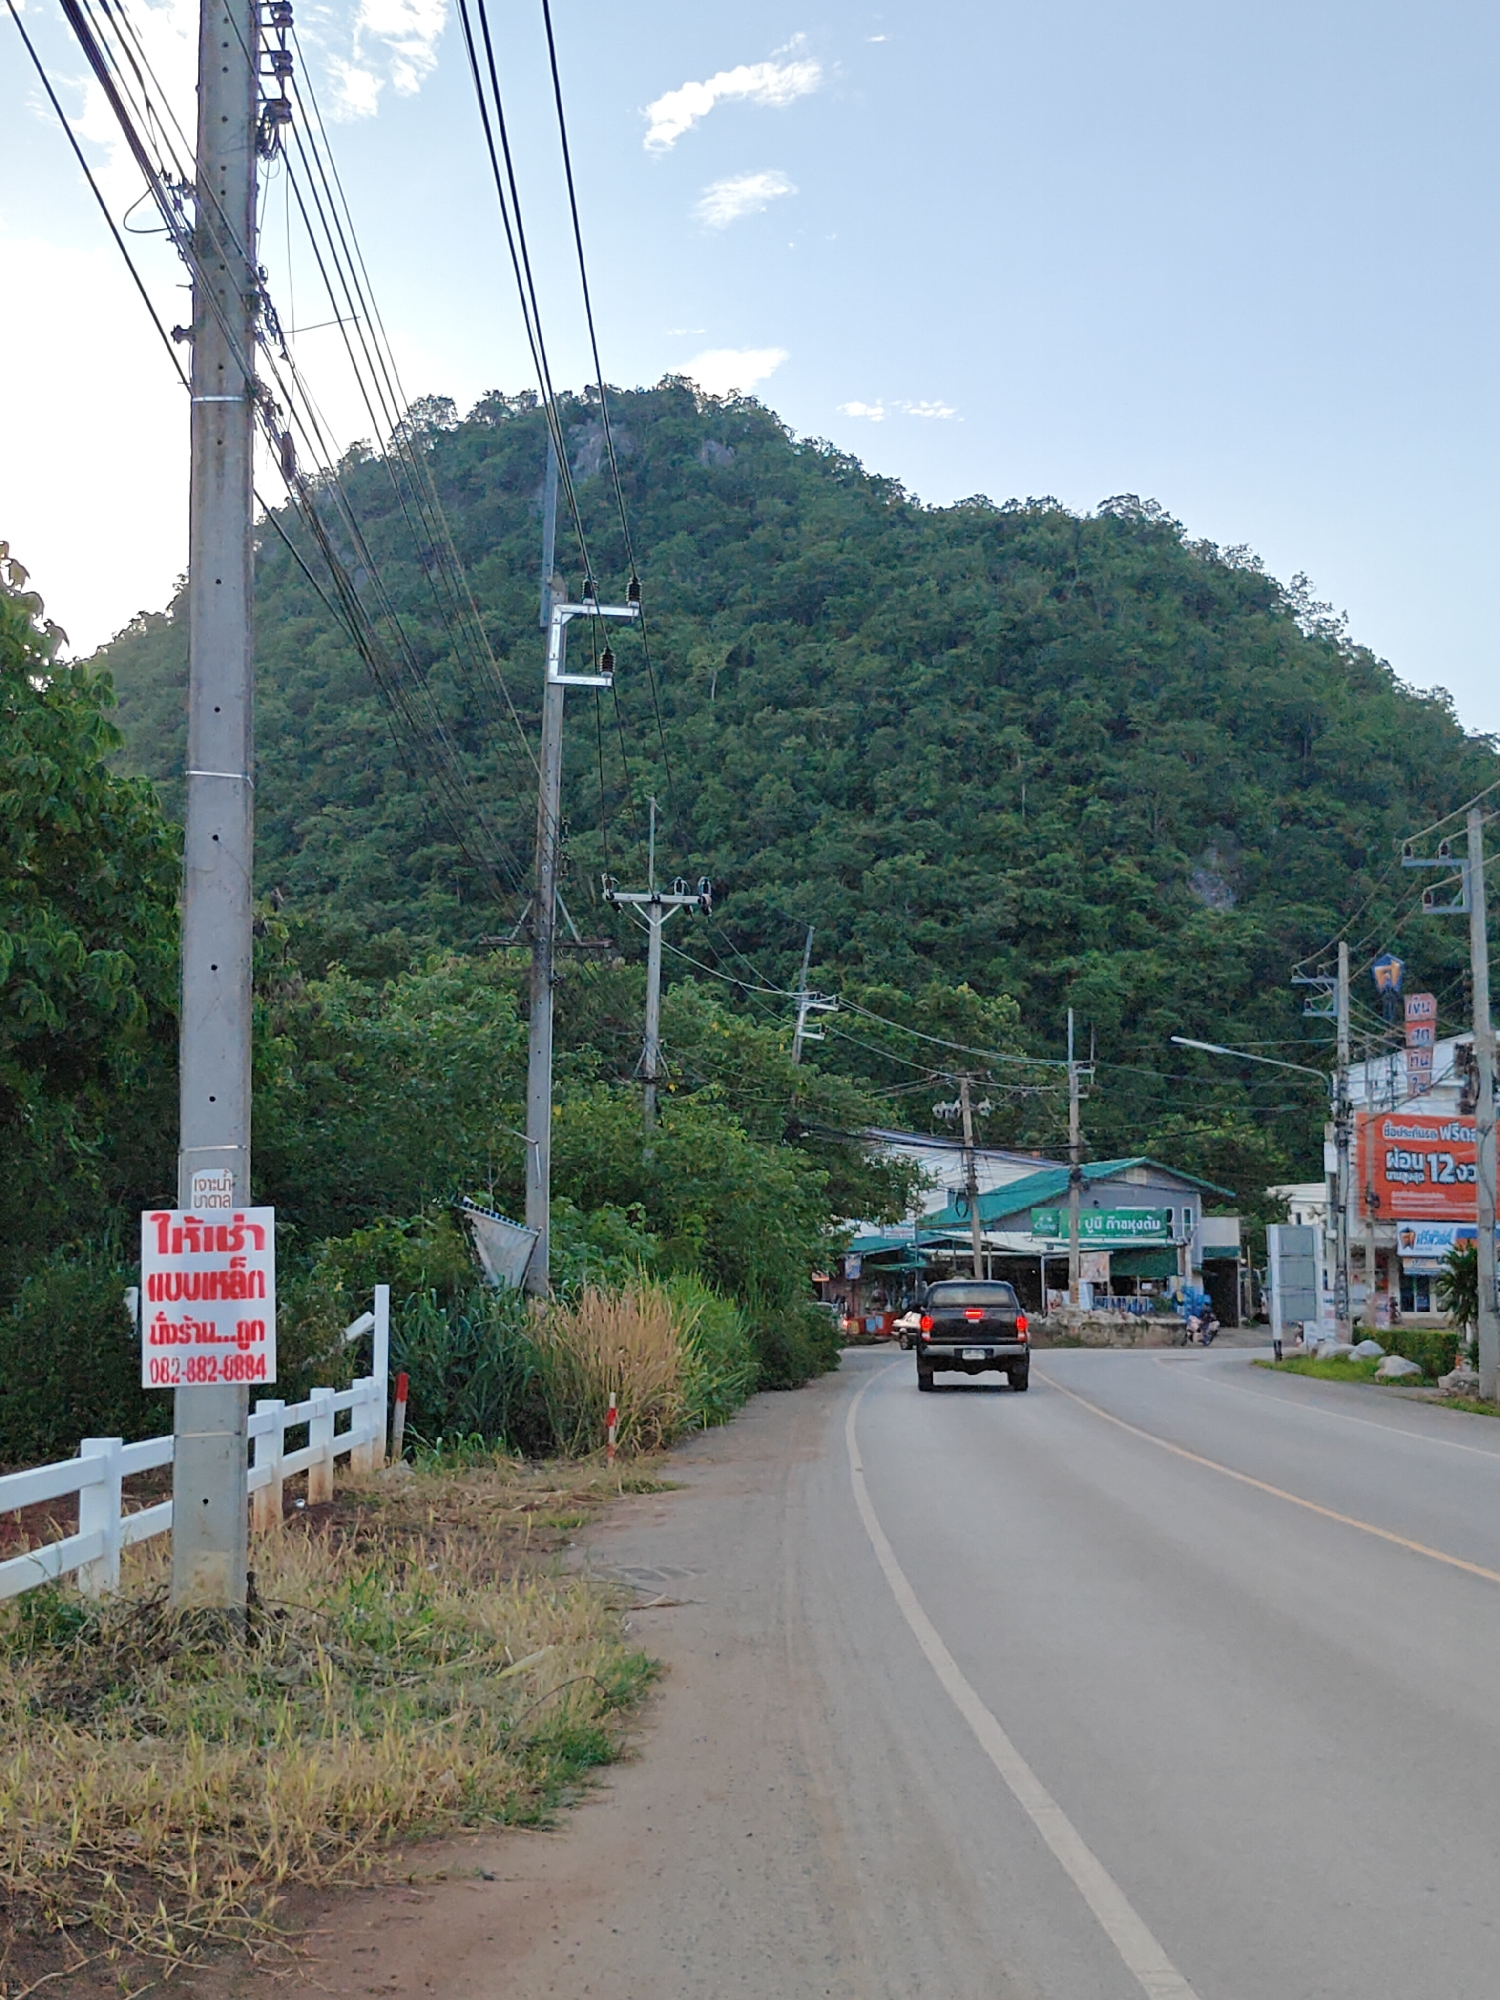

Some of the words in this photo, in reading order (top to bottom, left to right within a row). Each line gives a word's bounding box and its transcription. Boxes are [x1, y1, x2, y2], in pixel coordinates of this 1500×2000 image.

[194, 1169, 232, 1192] เจาะน้ำ
[1427, 1152, 1456, 1183] 12
[193, 1194, 231, 1209] บาดาล
[150, 1212, 266, 1254] ให้เช่า
[148, 1256, 266, 1302] แบบเหล็ก
